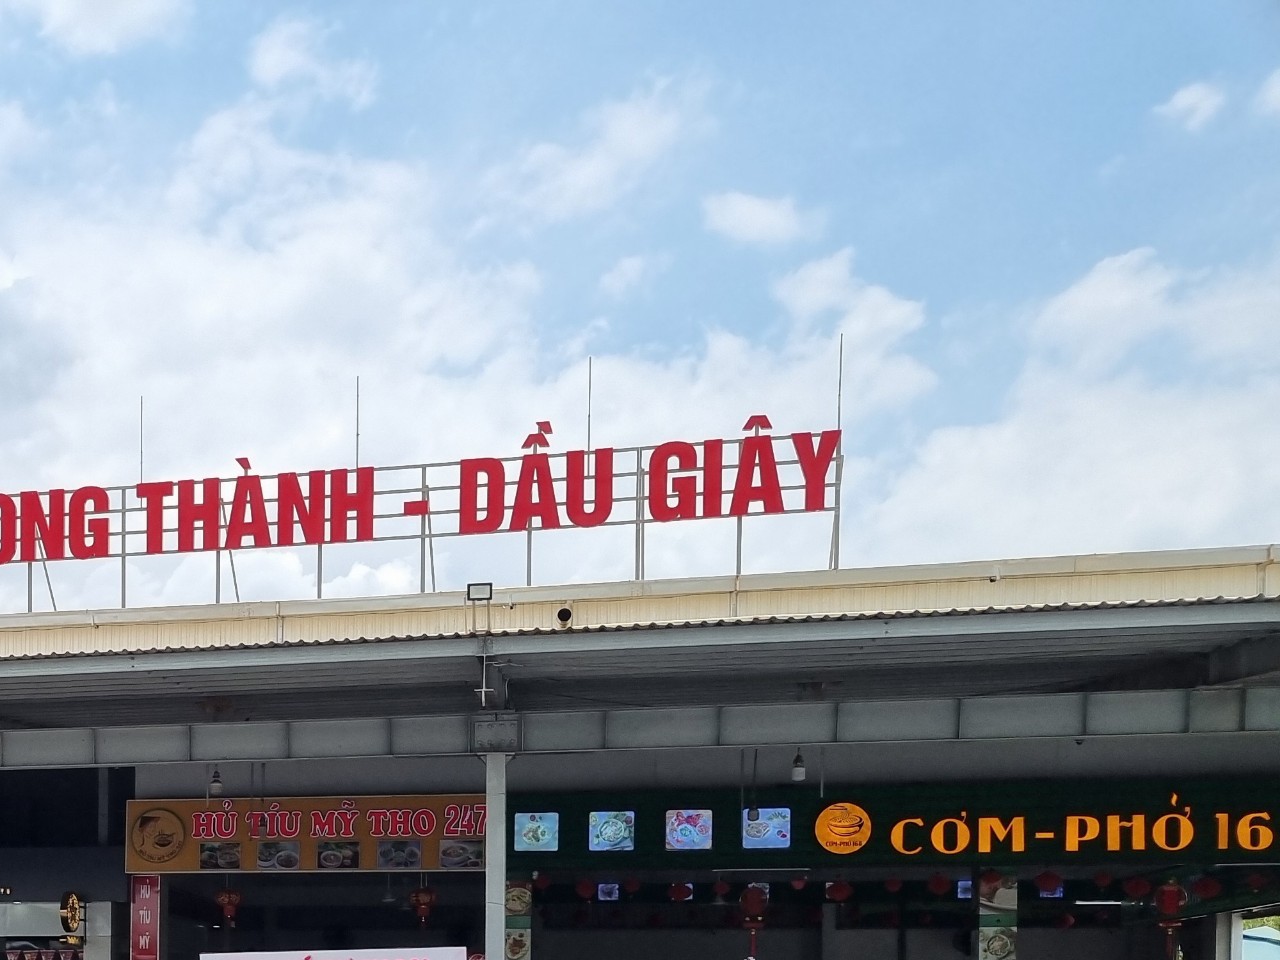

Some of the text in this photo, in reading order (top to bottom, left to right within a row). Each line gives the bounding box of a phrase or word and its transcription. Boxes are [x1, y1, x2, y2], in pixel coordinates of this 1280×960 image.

[136, 457, 375, 555] THÀNH
[459, 421, 614, 535] DẦU
[648, 415, 842, 523] GIÂY
[191, 800, 488, 839] HỦ TÍU MỸ THO 247
